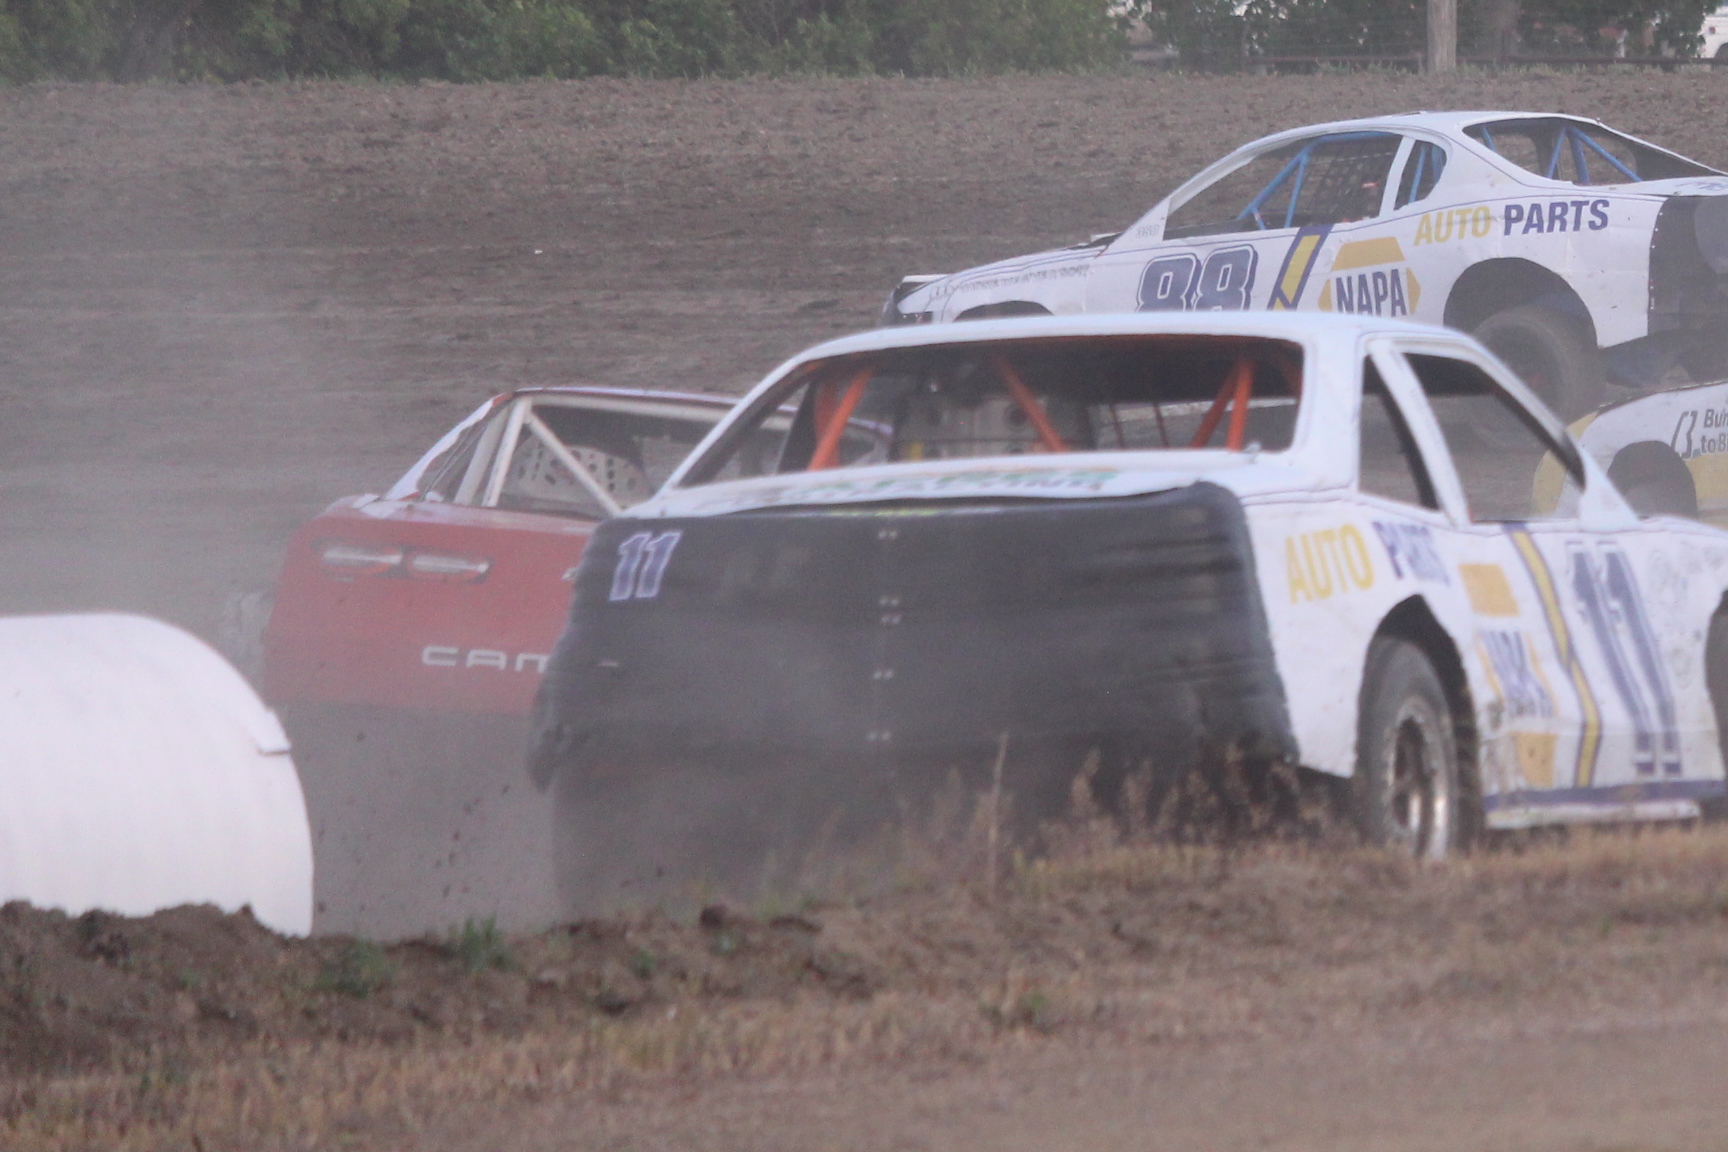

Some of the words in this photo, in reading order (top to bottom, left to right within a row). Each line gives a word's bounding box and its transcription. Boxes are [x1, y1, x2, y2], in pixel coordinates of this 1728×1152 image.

[1413, 205, 1491, 246] AUTO
[1504, 199, 1610, 236] PARTS
[1134, 244, 1260, 312] 88
[1335, 268, 1407, 317] NAPA
[610, 530, 683, 602] 11
[1285, 523, 1376, 605] AUTO
